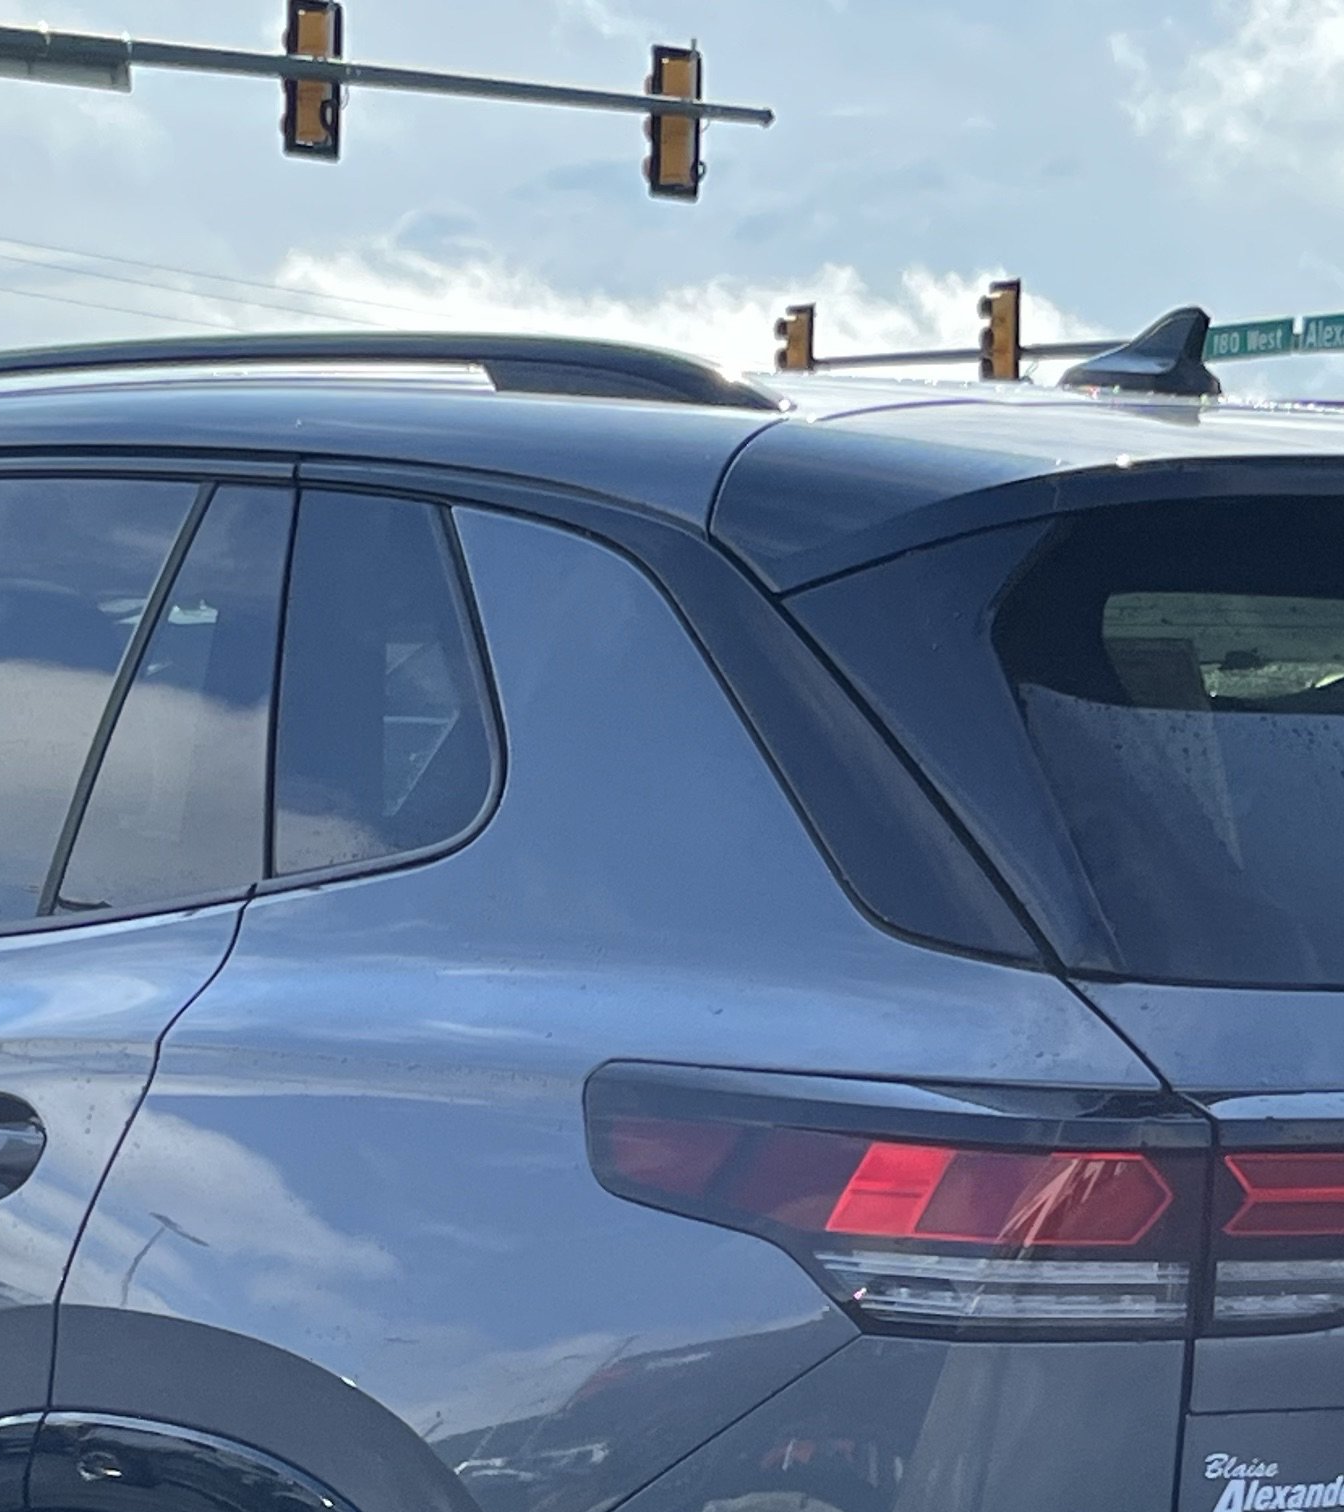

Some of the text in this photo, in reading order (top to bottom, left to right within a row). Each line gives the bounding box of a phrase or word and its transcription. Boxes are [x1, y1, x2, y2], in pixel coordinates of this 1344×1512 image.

[1212, 326, 1282, 356] 180 West
[1205, 1453, 1279, 1479] Blaise
